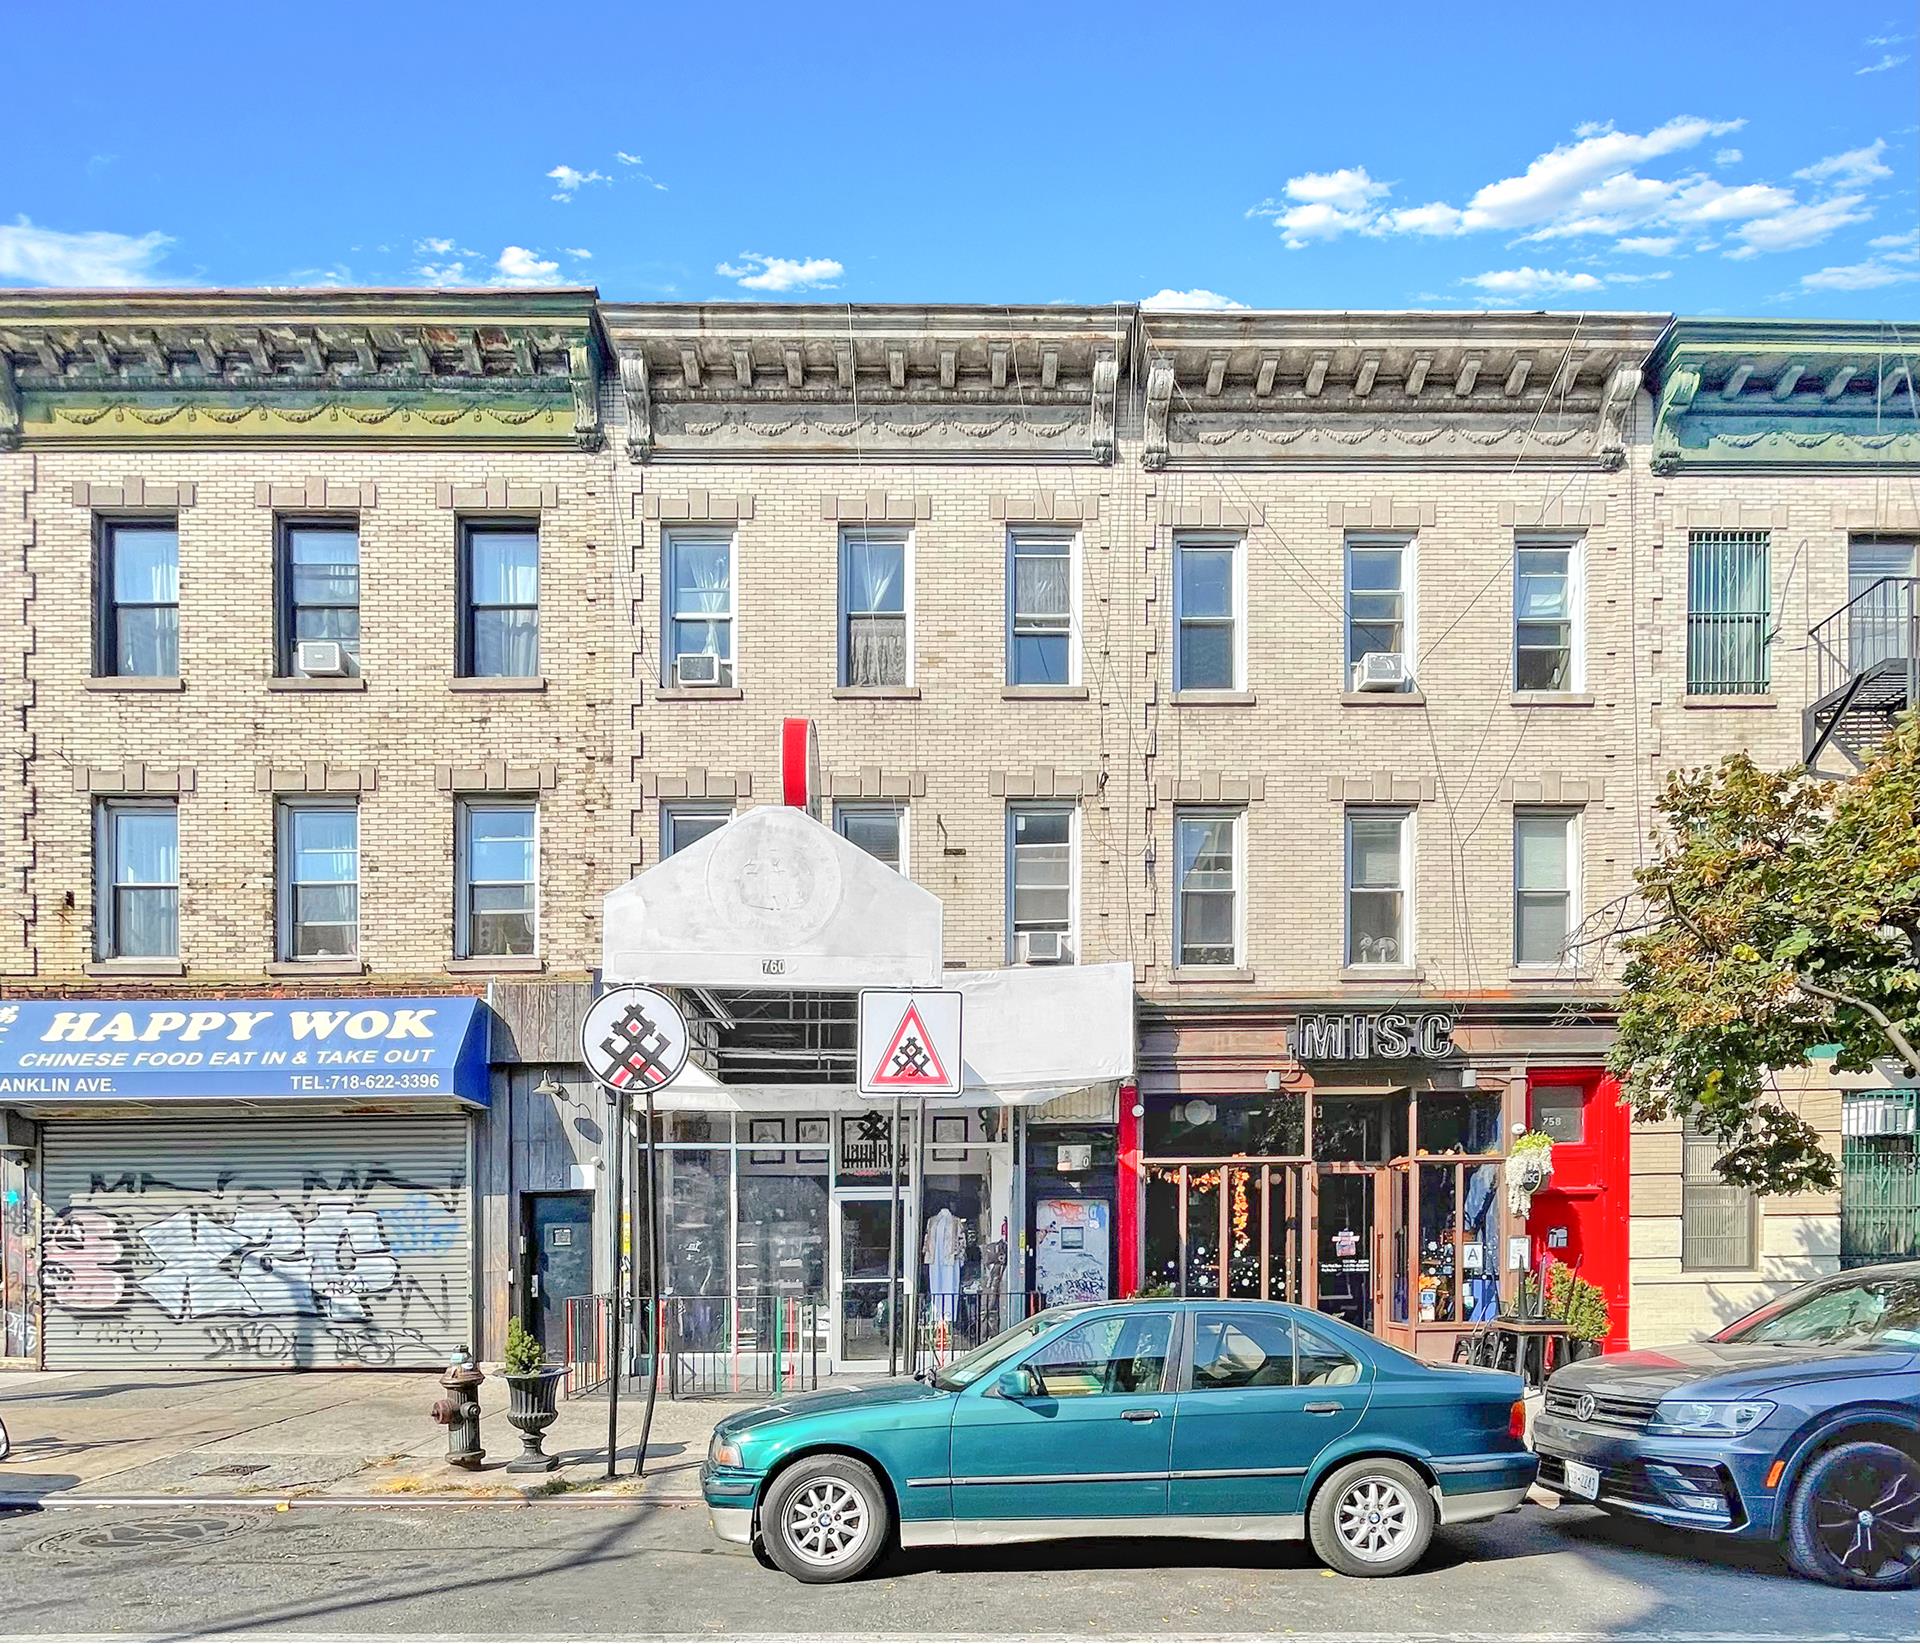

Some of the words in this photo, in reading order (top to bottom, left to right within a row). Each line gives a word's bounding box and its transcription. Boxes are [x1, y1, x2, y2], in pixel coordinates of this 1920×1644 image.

[761, 959, 785, 974] 760
[40, 1011, 274, 1042] HAPPY
[289, 1009, 437, 1041] WOK
[1296, 1013, 1453, 1059] MISC
[18, 1052, 129, 1067] CHINESE
[132, 1051, 204, 1066] FOOD
[209, 1051, 258, 1065] EAT
[260, 1051, 287, 1065] IN
[291, 1051, 308, 1064] &
[316, 1050, 377, 1064] TAKE
[384, 1049, 436, 1063] OUT
[74, 1078, 117, 1092] AVE.
[290, 1074, 439, 1089] TEL:718-622-3396
[1542, 1117, 1562, 1126] 758
[1468, 1248, 1479, 1261] A
